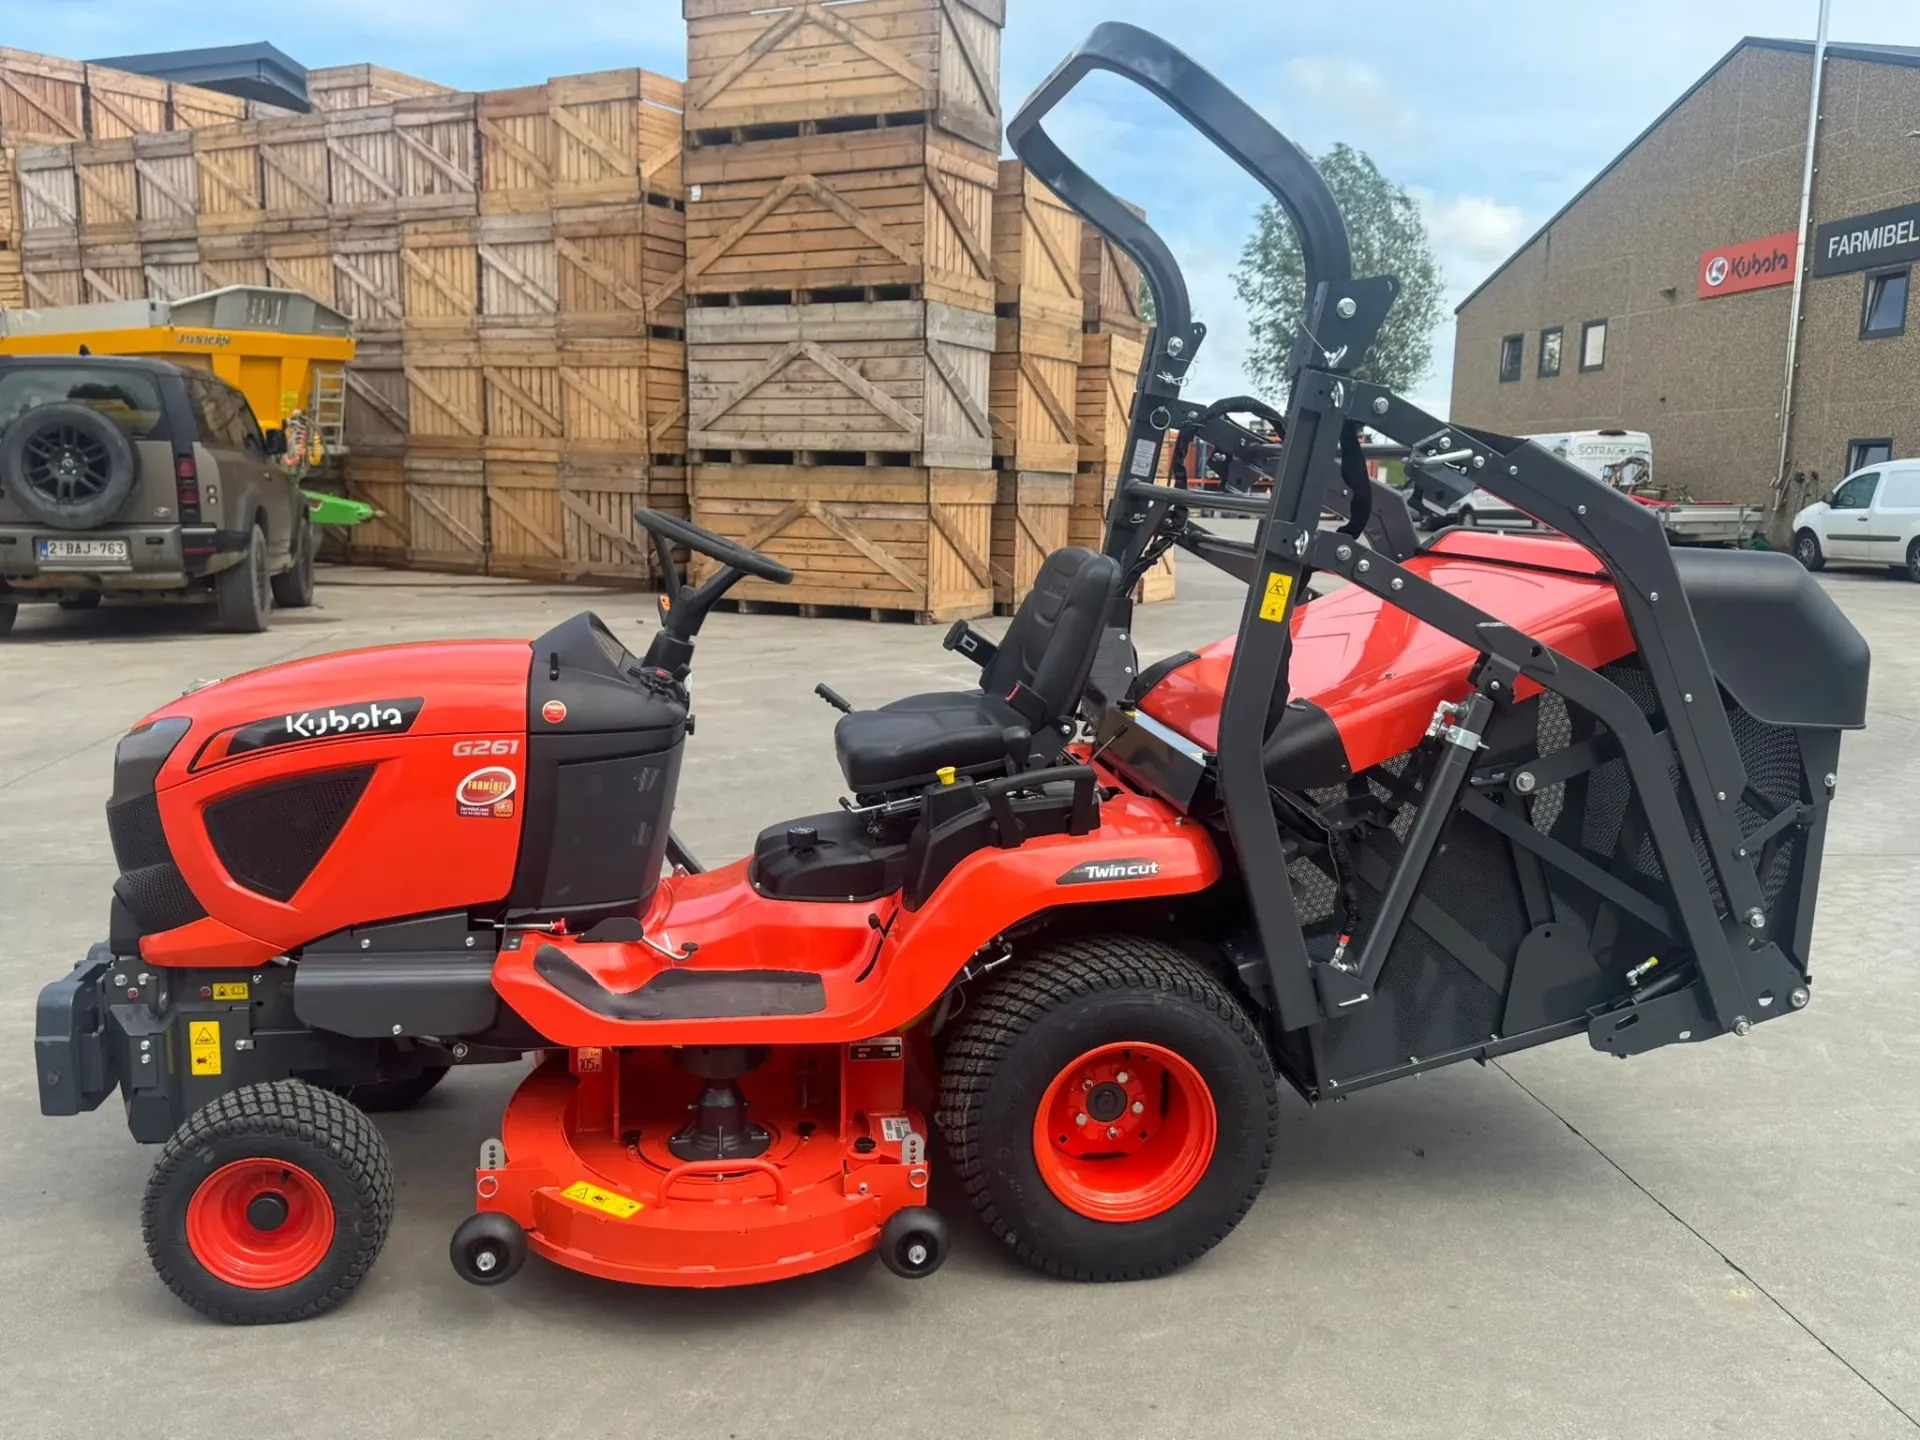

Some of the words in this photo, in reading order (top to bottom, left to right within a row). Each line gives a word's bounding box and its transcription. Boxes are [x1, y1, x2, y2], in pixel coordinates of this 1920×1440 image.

[1828, 220, 1920, 259] FARMIBEL
[1731, 248, 1788, 278] Kubota
[285, 703, 402, 737] Kubota
[452, 740, 519, 757] G261
